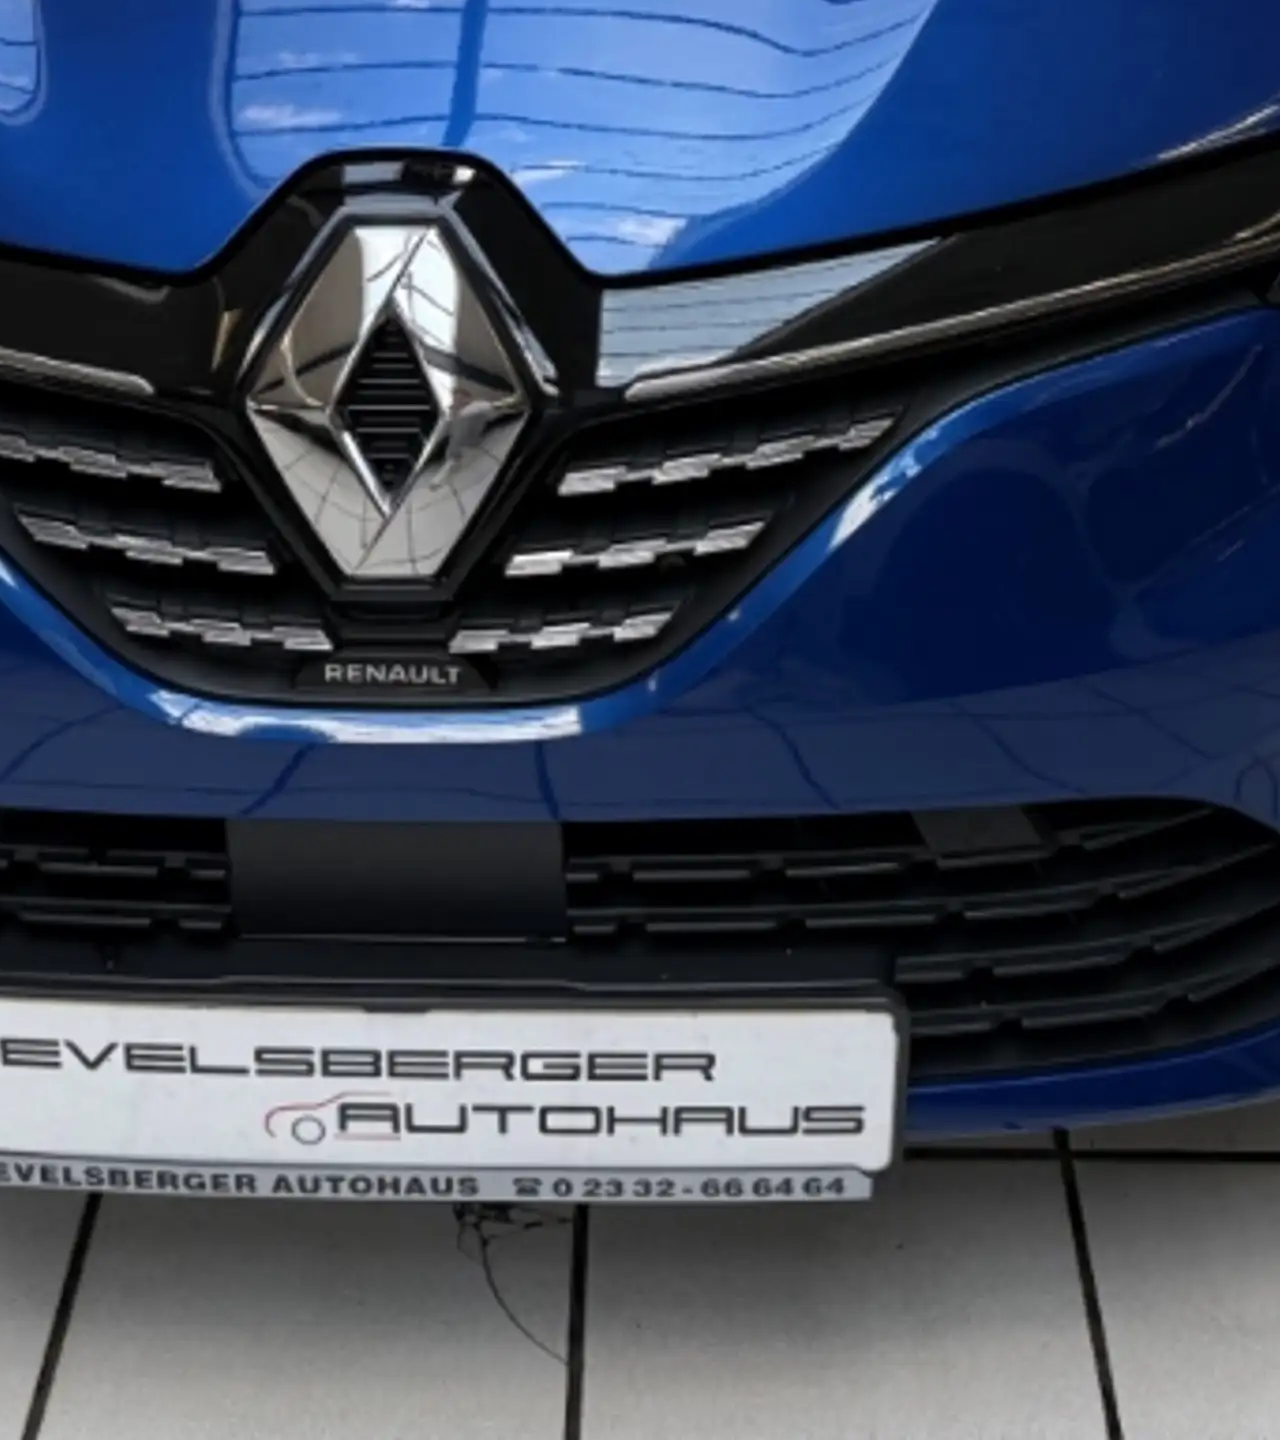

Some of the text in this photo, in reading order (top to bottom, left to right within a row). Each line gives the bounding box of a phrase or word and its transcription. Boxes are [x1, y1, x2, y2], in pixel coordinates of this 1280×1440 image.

[324, 662, 462, 685] RENAULT
[336, 1102, 867, 1136] AUTOHAUS
[271, 1173, 482, 1198] AUTOHAUS
